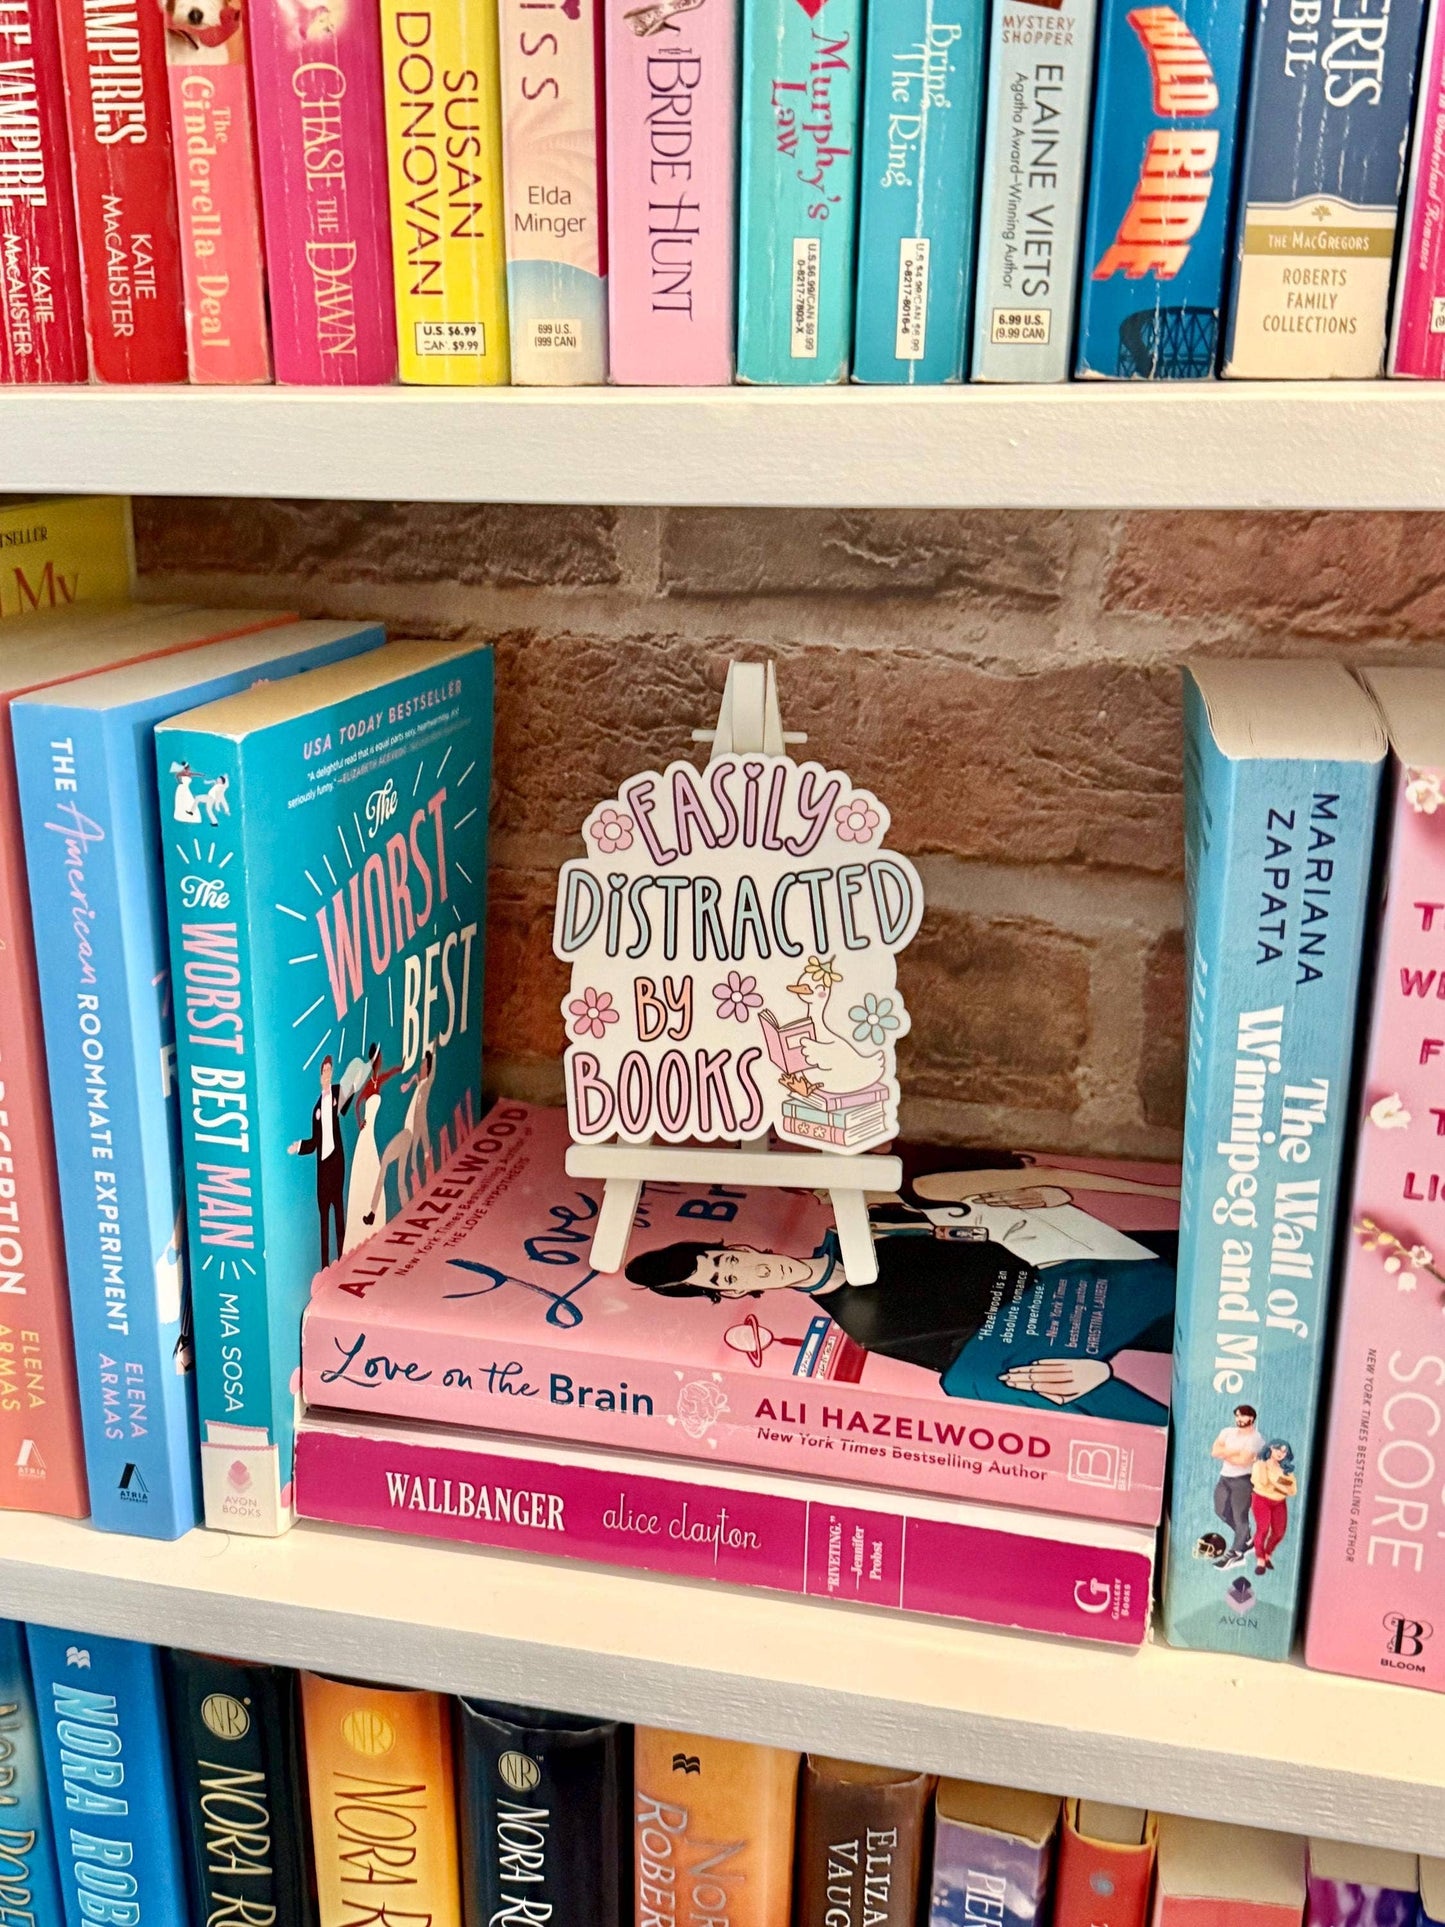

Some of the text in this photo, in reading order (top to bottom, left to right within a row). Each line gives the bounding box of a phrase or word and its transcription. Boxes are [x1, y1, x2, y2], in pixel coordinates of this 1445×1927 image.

[1002, 30, 1073, 45] SHOPPER
[1003, 14, 1076, 30] MYSTERY
[927, 23, 962, 108] Bring
[1125, 4, 1221, 118] WILD
[211, 106, 230, 143] The
[396, 11, 444, 297] DONOVAN
[443, 69, 485, 239] SUSAN
[771, 79, 808, 158] Law
[798, 29, 851, 221] Murphy's
[881, 112, 922, 188] Ring
[180, 75, 231, 348] Cinderella Deal
[292, 62, 358, 359] CHASE THE DAWN
[528, 186, 571, 205] Elda
[646, 55, 701, 322] BRIDE HUNT
[1002, 72, 1029, 289] Agatha Award-Winning Author
[1021, 64, 1064, 297] ELAINE VIETS
[1090, 129, 1221, 281] RIDE
[514, 212, 587, 237] Minger
[1268, 235, 1287, 249] THE
[30, 265, 54, 324] KATIE
[130, 233, 157, 299] KATIE
[1282, 268, 1348, 287] ROBERTS
[1286, 293, 1337, 310] FAMILY
[448, 326, 477, 336] $6.99
[453, 341, 479, 351] $9.99
[554, 336, 577, 347] CAN)
[998, 314, 1045, 327] 6.99 U.S.
[1262, 315, 1358, 335] COLLECTIONS
[303, 733, 332, 760] USA
[339, 711, 383, 745] TODAY
[388, 679, 462, 724] BESTSELLER
[287, 789, 317, 809] seriously
[315, 758, 343, 780] delightful
[344, 753, 358, 767] read
[365, 778, 398, 838] The
[315, 787, 448, 1022] WORST
[1256, 807, 1295, 965] ZAPATA
[1295, 793, 1340, 985] MARIANA
[402, 922, 477, 1074] BEST
[633, 974, 693, 1043] BY
[44, 737, 129, 1336] THE American ROOMMATE EXPERIMENT
[180, 875, 254, 1249] The WORST BEST MAN
[571, 1047, 764, 1135] BOOKS
[338, 1256, 397, 1299] ALI
[384, 1107, 528, 1246] HAZELWOOD
[443, 1156, 531, 1248] THE LOVE HYPOTHESIS
[1212, 1005, 1285, 1395] Winnipeg and Me
[1265, 1077, 1330, 1340] The Wall of
[394, 1256, 420, 1276] New
[417, 1236, 439, 1256] York
[436, 1209, 465, 1236] Times
[998, 1270, 1007, 1281] an
[1002, 1270, 1028, 1344] absolute romance
[21, 1330, 46, 1408] ELENA
[219, 1293, 244, 1413] MIA SOSA
[321, 1333, 654, 1416] Love on the Brain
[99, 1353, 124, 1440] ARMAS
[124, 1362, 148, 1438] ELENA
[755, 1398, 1052, 1460] ALI HAZELWOOD
[757, 1427, 1049, 1483] New York Times Bestselling Author
[1346, 1348, 1377, 1563] NEW YORK TIMES BESTSELLING AUTHOR
[1367, 1350, 1445, 1573] SCORE
[222, 1505, 262, 1518] BOOKS
[224, 1496, 258, 1508] AVON
[385, 1471, 566, 1531] WALLBANGER
[602, 1492, 762, 1566] alice clayton
[869, 1541, 883, 1581] Probst
[1111, 1578, 1122, 1620] GALLERY
[1121, 1583, 1132, 1617] BOOKS
[1219, 1615, 1258, 1630] AVON
[1380, 1658, 1426, 1673] BLOOM
[53, 1682, 128, 1815] NORA
[198, 1760, 273, 1877] NORA
[333, 1771, 428, 1885] NORA
[497, 1798, 549, 1882] NORA
